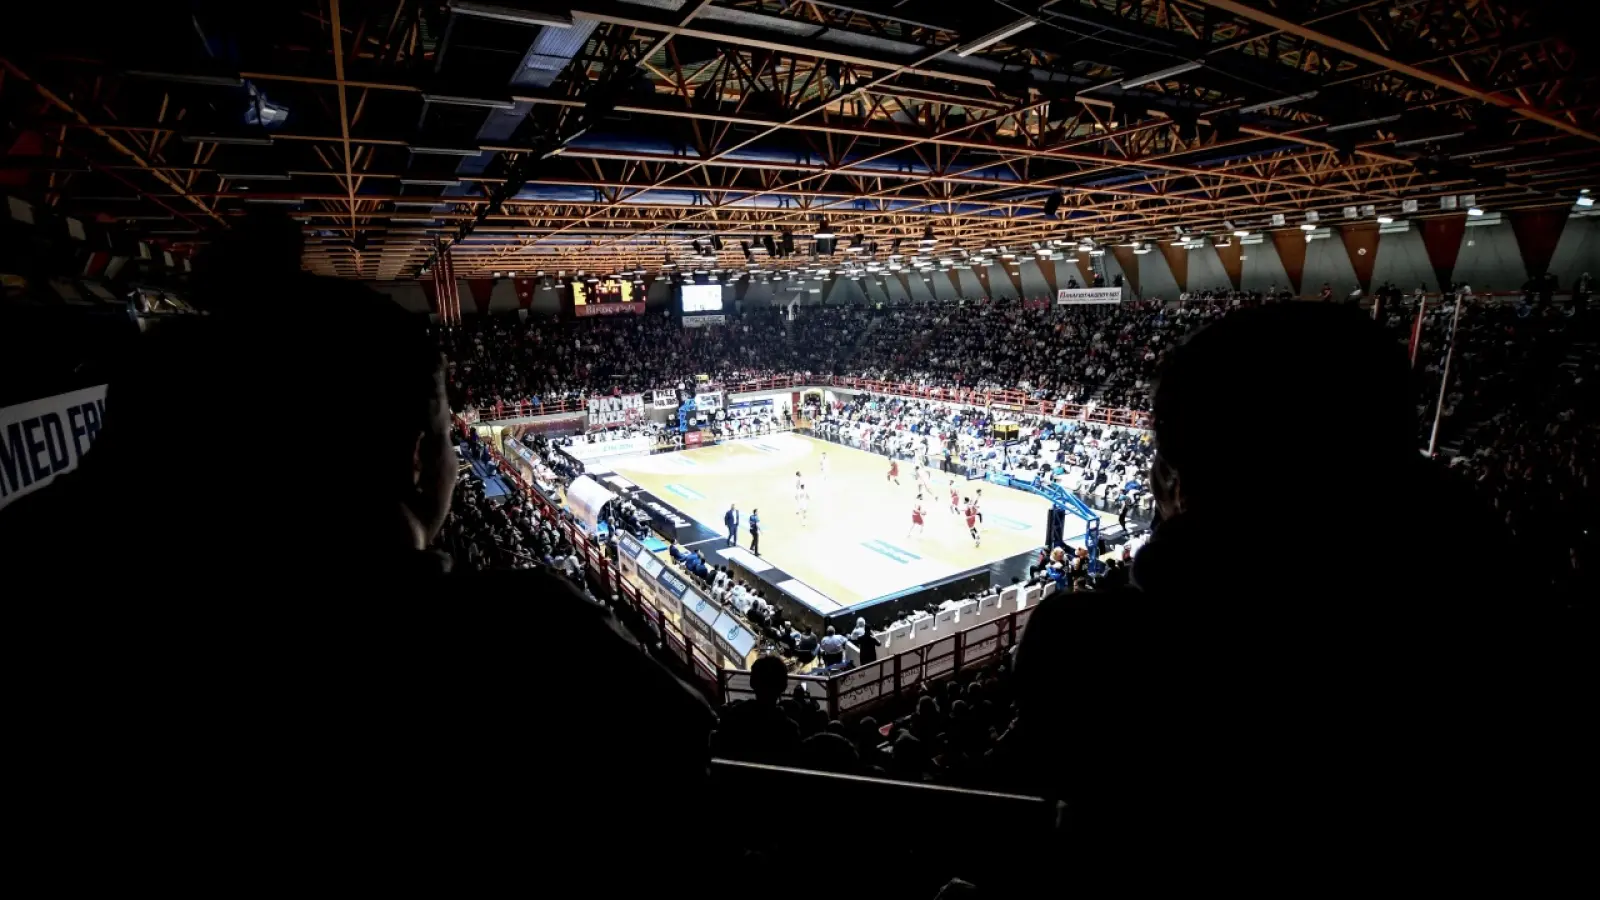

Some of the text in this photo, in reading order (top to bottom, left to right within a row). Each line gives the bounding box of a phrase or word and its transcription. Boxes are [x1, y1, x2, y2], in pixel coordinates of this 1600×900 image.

[588, 394, 644, 414] PATRA
[588, 409, 626, 425] GATE
[0, 411, 70, 498] MED
